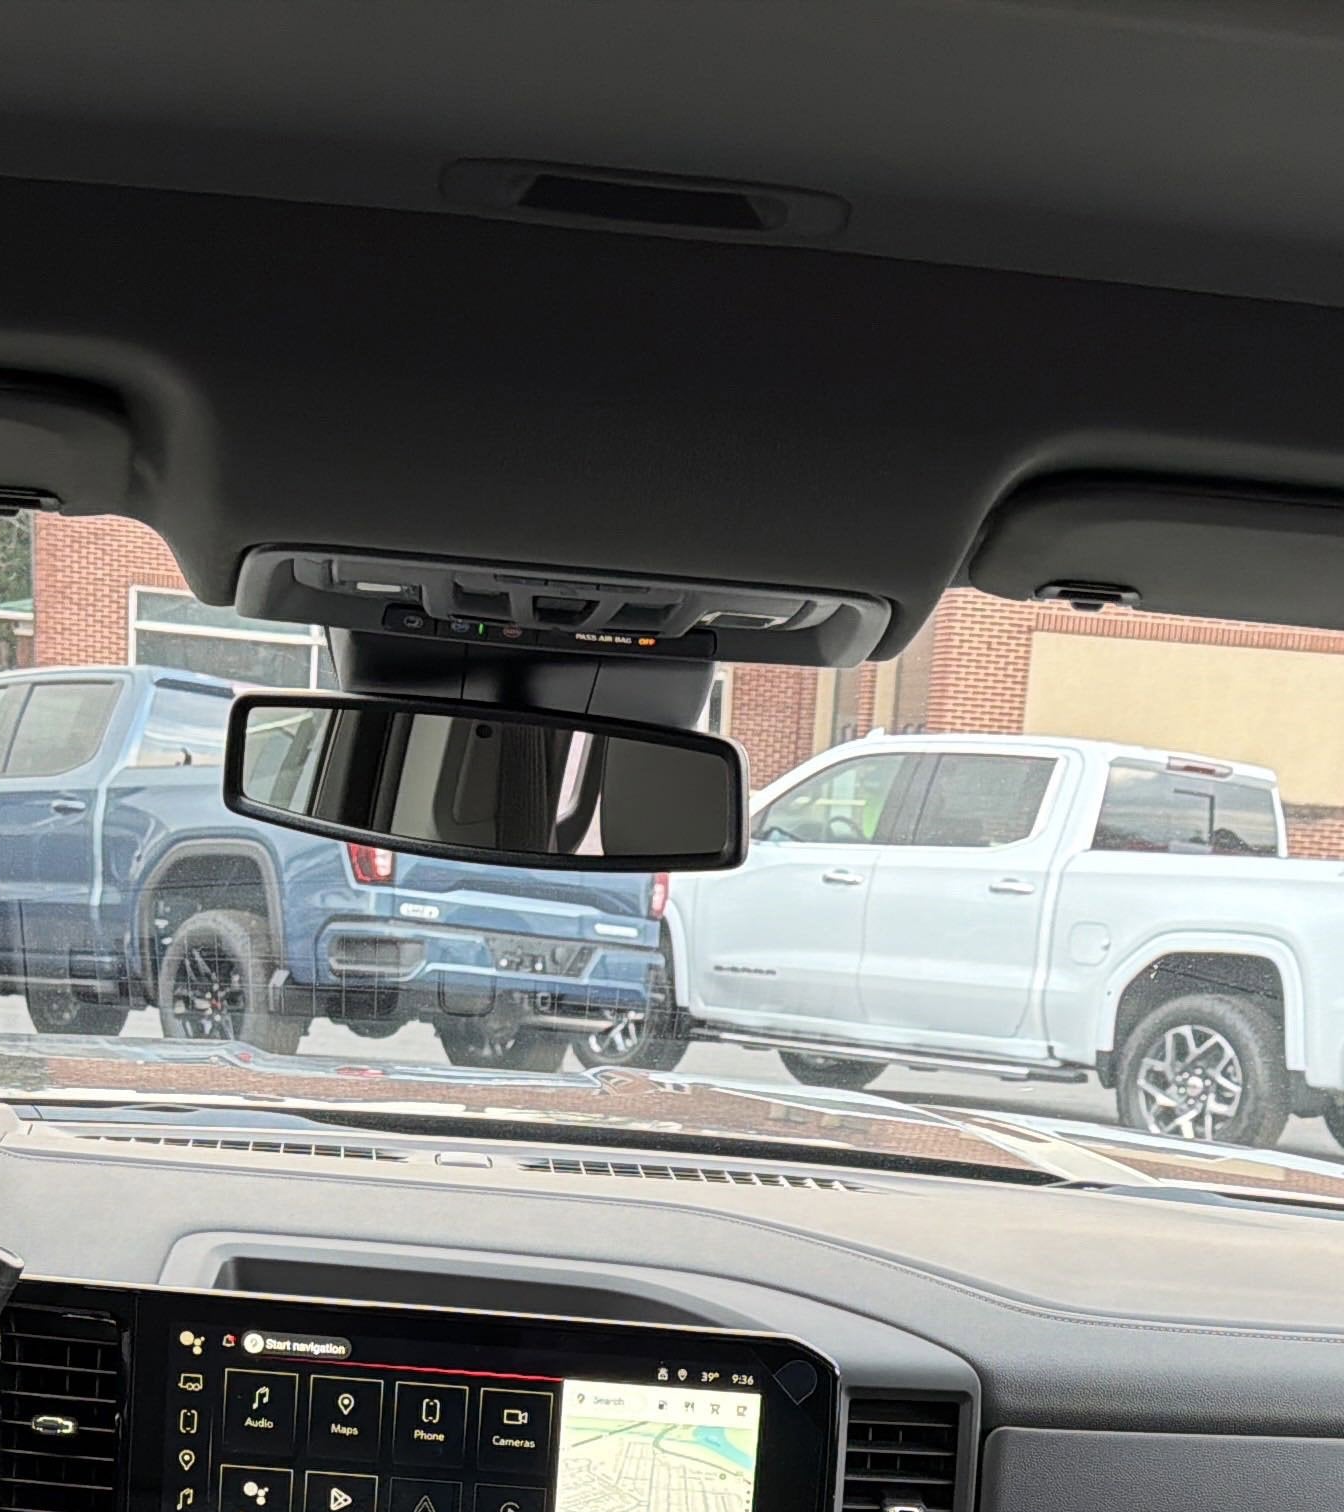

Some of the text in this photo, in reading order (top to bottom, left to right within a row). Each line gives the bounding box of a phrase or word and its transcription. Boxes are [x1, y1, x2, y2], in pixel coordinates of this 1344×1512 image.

[265, 1338, 346, 1357] Start navigation
[731, 1374, 754, 1386] 9:36
[244, 1416, 274, 1429] Audio
[330, 1423, 359, 1436] Maps
[414, 1429, 445, 1442] Phone
[492, 1435, 536, 1449] Cameras
